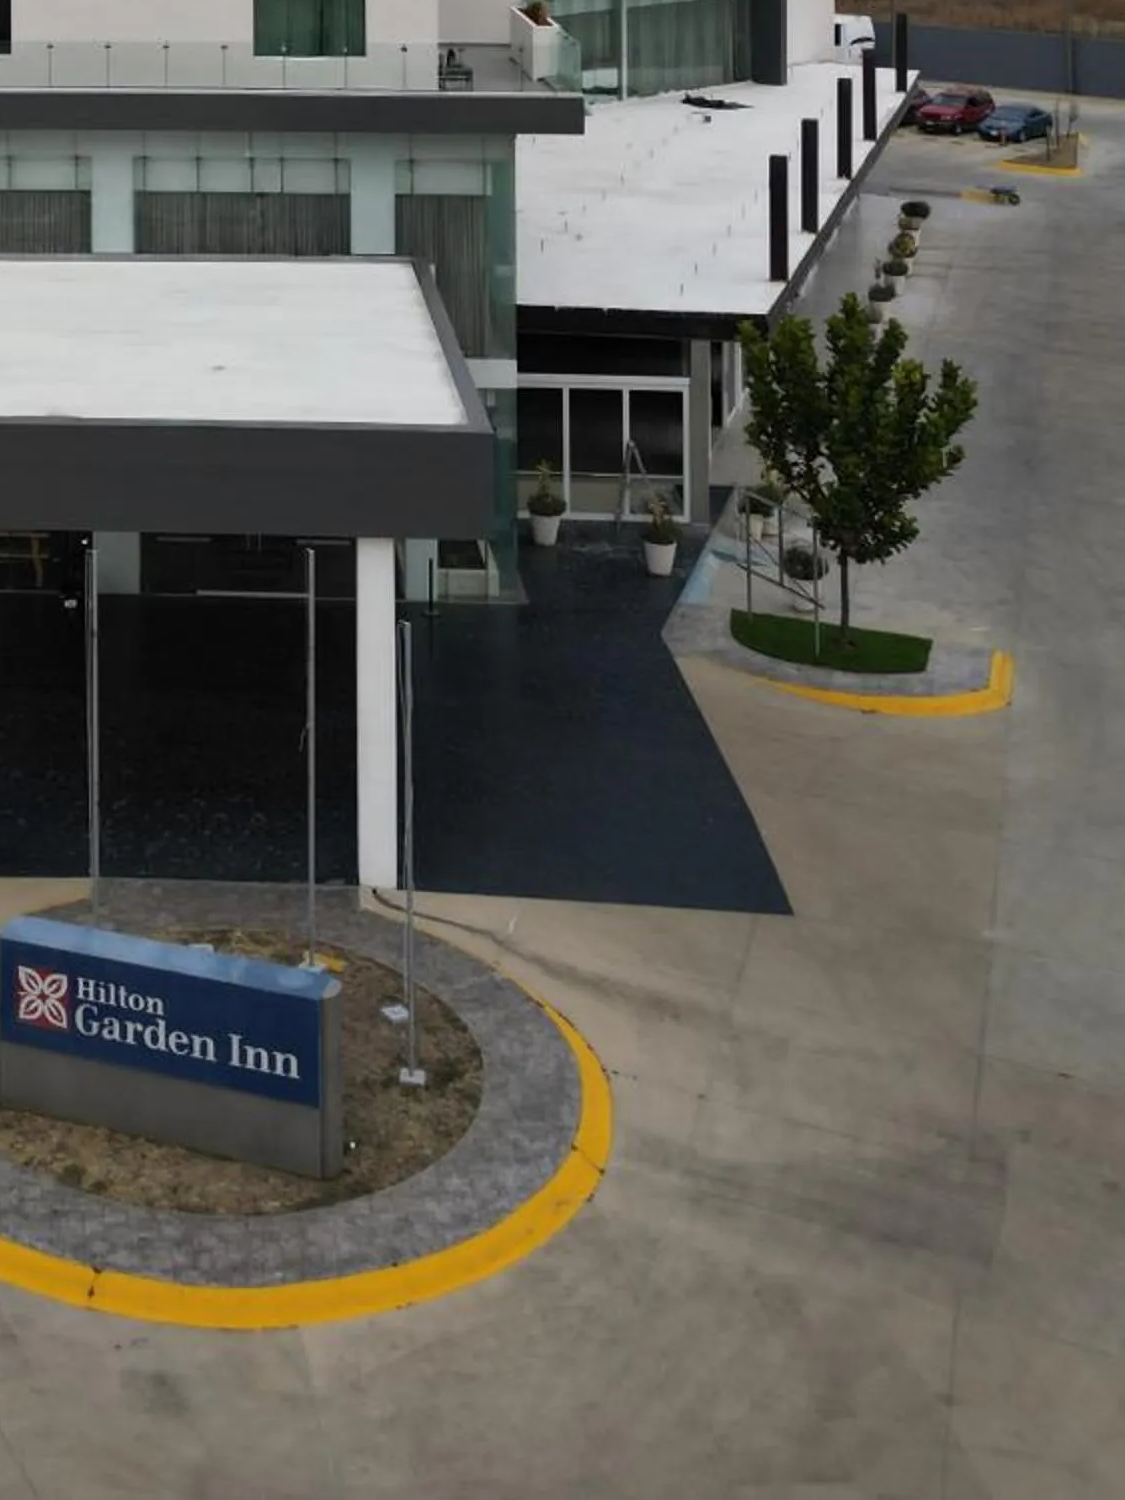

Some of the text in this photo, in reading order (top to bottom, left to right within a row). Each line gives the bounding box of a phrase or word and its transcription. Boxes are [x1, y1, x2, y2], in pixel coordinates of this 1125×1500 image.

[76, 977, 165, 1016] Hilton
[75, 1003, 300, 1079] Garden Inn
